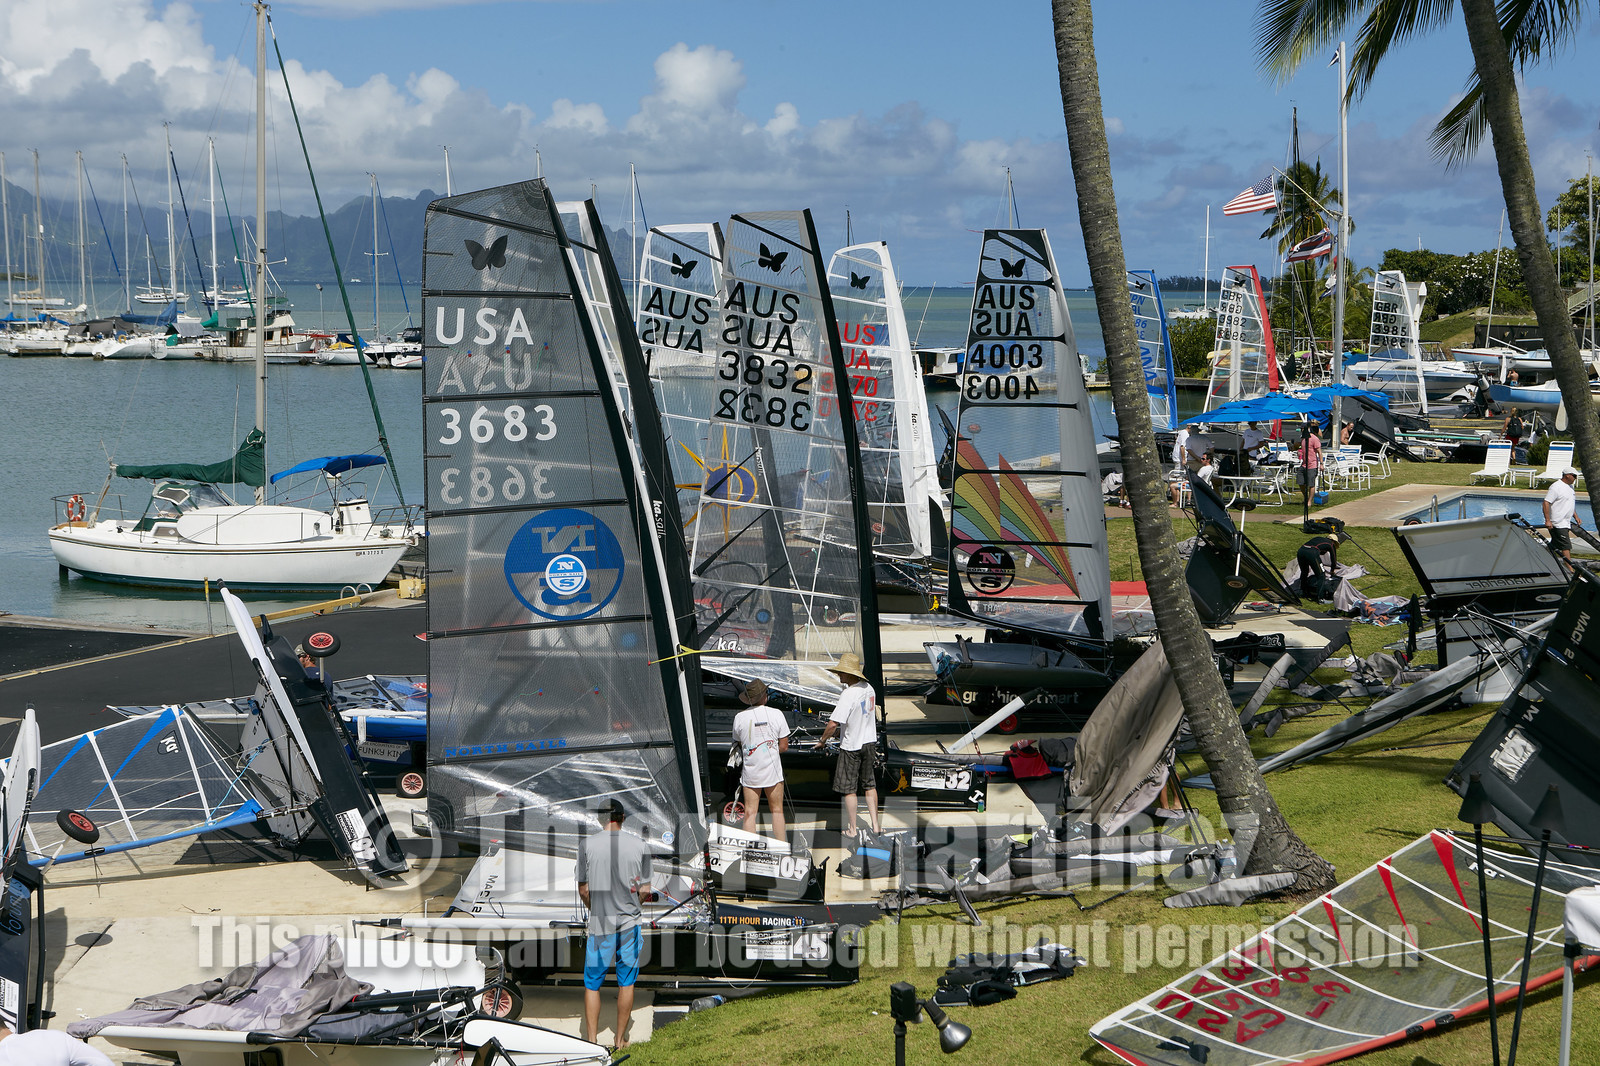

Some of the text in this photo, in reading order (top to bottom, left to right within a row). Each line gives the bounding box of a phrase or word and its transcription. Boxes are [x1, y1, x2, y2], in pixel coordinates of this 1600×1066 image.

[725, 282, 799, 324] AUS
[978, 285, 1035, 309] AUS
[1130, 293, 1145, 305] PN
[1222, 290, 1243, 302] GBR
[645, 288, 712, 325] AUS
[1376, 302, 1398, 313] GBR
[435, 307, 534, 345] USA
[1219, 314, 1247, 327] 3982
[1373, 324, 1407, 336] 3985
[836, 322, 876, 345] US
[970, 344, 1043, 368] 4003
[719, 351, 812, 395] 3832
[821, 372, 879, 397] 370
[439, 405, 557, 445] 3683
[556, 561, 576, 571] N
[559, 578, 575, 587] S
[980, 577, 1001, 588] S
[445, 739, 567, 757] NORTH SAILS
[945, 770, 971, 790] 32
[720, 837, 755, 849] MACH
[780, 855, 810, 880] 05
[719, 916, 792, 926] 11TH HOUR RACING
[793, 933, 828, 959] 45
